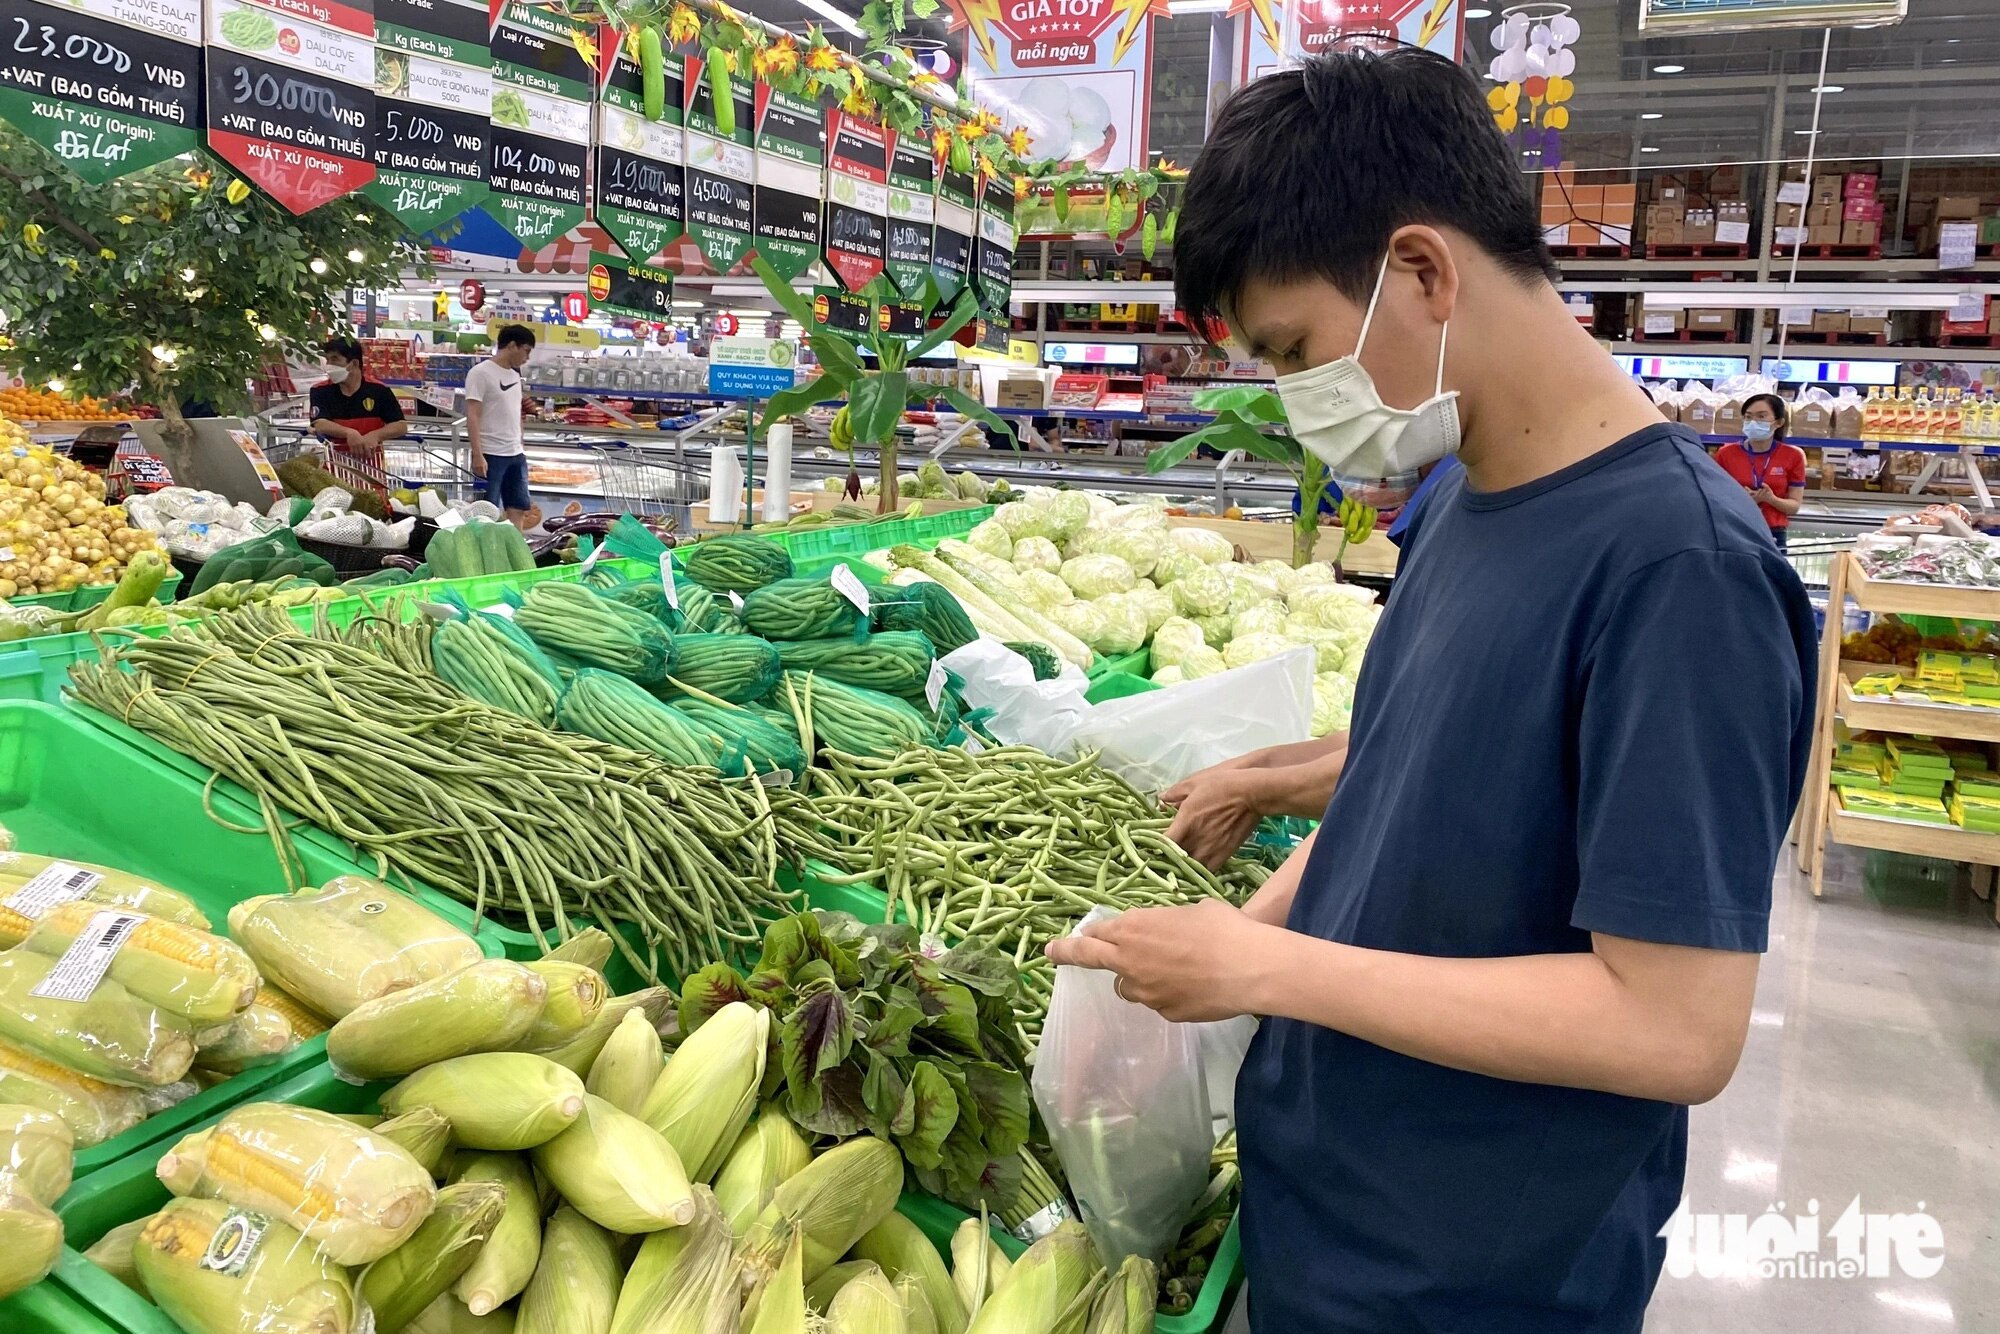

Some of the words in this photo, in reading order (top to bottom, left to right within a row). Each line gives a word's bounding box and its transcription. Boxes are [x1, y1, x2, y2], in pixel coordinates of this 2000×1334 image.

[112, 6, 187, 36] T.HANG-500G
[162, 4, 197, 24] DALAT
[280, 0, 309, 14] (Each
[313, 5, 331, 21] kg):
[532, 16, 554, 31] Mega
[396, 33, 407, 48] Kg
[410, 37, 435, 52] (Each
[438, 44, 454, 57] kg):
[502, 30, 517, 44] Loại
[524, 36, 545, 50] Grade:
[1306, 26, 1341, 45] mỗi
[14, 17, 131, 73] 23.000
[144, 63, 185, 88] VNĐ
[306, 40, 326, 55] DAU
[329, 44, 355, 62] COVE
[1016, 42, 1047, 60] mỗi
[1049, 42, 1089, 61] ngày
[315, 57, 346, 73] DALAT
[621, 61, 632, 73] Loại
[410, 73, 425, 84] DAU
[427, 77, 447, 88] COVE
[471, 86, 489, 97] NHAT
[515, 71, 525, 85] Kg
[526, 75, 547, 89] (Each
[548, 80, 560, 94] kg):
[0, 66, 45, 87] +VAT
[51, 76, 92, 99] (BAO
[98, 84, 133, 109] GỒM
[139, 98, 184, 123] THUẾ)
[233, 66, 336, 118] 30.000
[333, 106, 365, 128] VNĐ
[442, 92, 460, 103] 500G
[609, 90, 621, 104] MỖI
[630, 99, 637, 111] Kg
[32, 101, 75, 122] XUẤT
[106, 118, 156, 141] (Origin):
[528, 108, 541, 119] DAU
[222, 114, 256, 131] +VAT
[261, 121, 292, 140] (BAO
[297, 126, 325, 147] GỒM
[329, 137, 365, 158] THUẾ)
[453, 134, 481, 151] VNĐ
[92, 134, 131, 166] Lạt
[248, 142, 281, 160] XUẤT
[305, 155, 344, 174] (Origin):
[392, 153, 418, 168] (BAO
[422, 153, 446, 172] GỒM
[449, 160, 481, 179] THUẾ)
[495, 145, 556, 174] 104.000
[558, 162, 580, 178] VNĐ
[379, 171, 407, 187] XUẤT
[428, 181, 461, 195] (Origin):
[511, 179, 532, 192] (BAO
[534, 180, 553, 197] GỒM
[556, 186, 579, 203] THUẾ)
[663, 181, 680, 196] VNĐ
[693, 177, 732, 204] 45.000
[736, 198, 750, 211] VNĐ
[502, 196, 523, 209] XUẤT
[540, 204, 565, 219] (Origin):
[605, 193, 623, 204] +VAT
[625, 196, 641, 208] (BAO
[643, 198, 658, 213] GỒM
[660, 203, 679, 219] THUẾ)
[617, 212, 635, 225] XUẤT
[646, 221, 667, 233] (Origin):
[692, 210, 706, 221] +VAT
[707, 213, 720, 225] (BAO
[721, 214, 734, 227] GỒM
[735, 218, 750, 232] THUẾ)
[802, 211, 816, 223] VNĐ
[702, 228, 715, 238] XUẤT
[725, 235, 742, 246] (Origin):
[760, 224, 772, 234] +VAT
[774, 226, 787, 237] (BAO
[788, 226, 800, 238] GỒM
[801, 230, 815, 242] THUẾ)
[869, 228, 881, 239] VNĐ
[920, 237, 930, 246] VNĐ
[832, 240, 843, 249] +VAT
[844, 242, 856, 251] (BAO
[354, 290, 365, 299] 12
[377, 292, 387, 301] 11
[461, 285, 475, 304] 12
[570, 299, 581, 316] 11
[720, 317, 730, 332] 9
